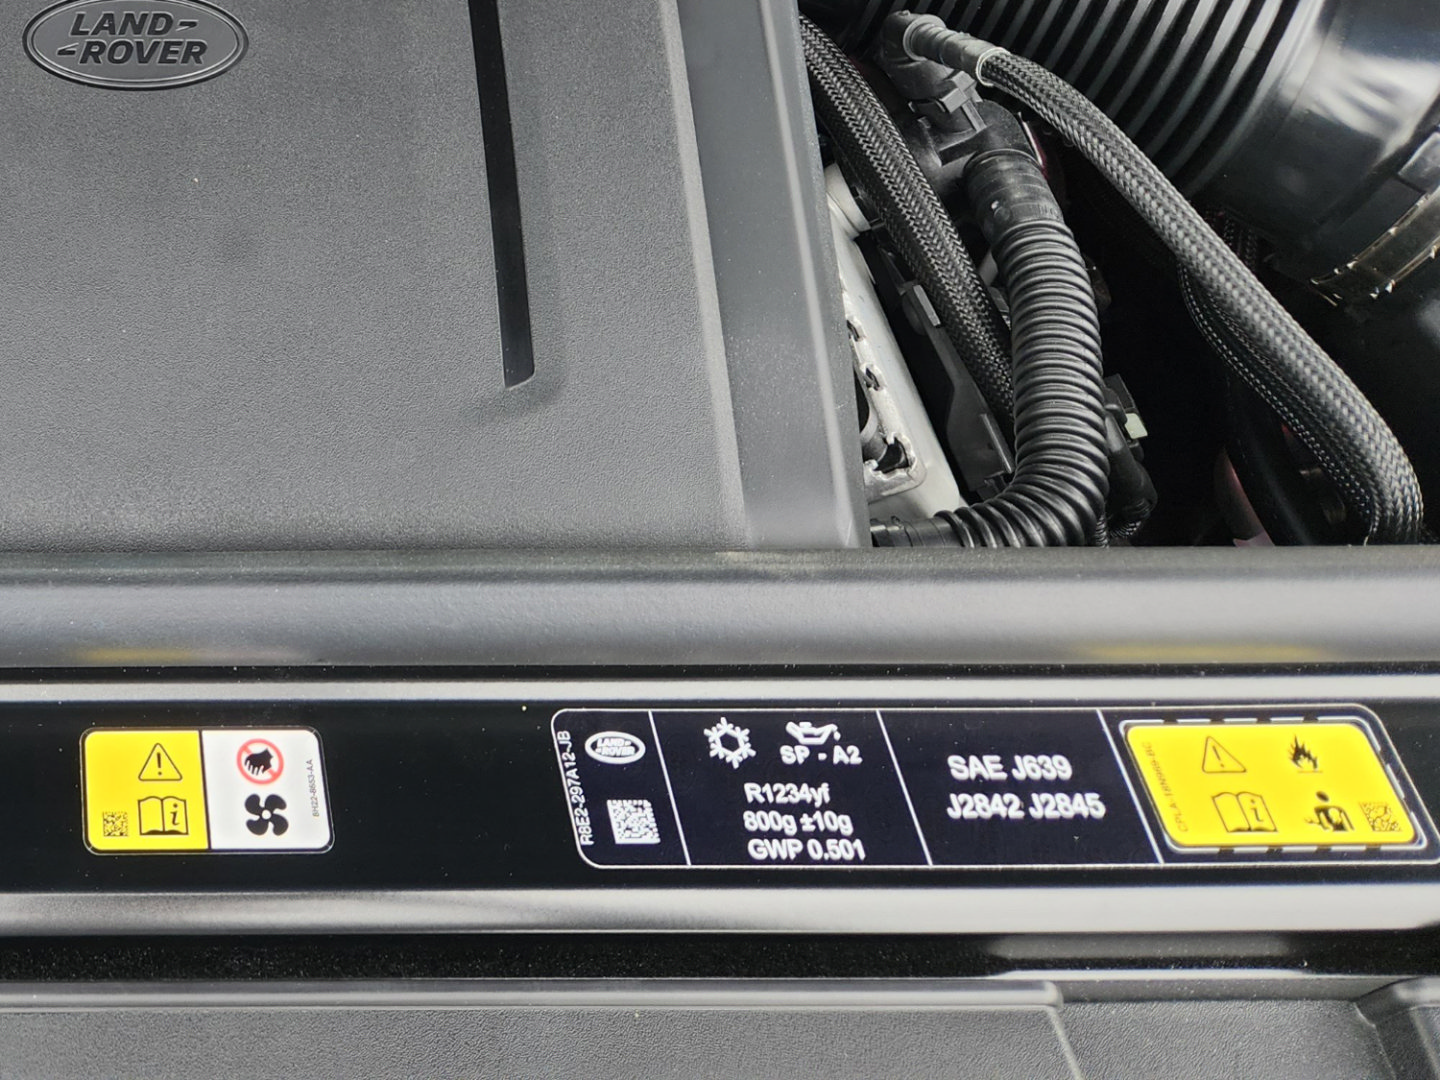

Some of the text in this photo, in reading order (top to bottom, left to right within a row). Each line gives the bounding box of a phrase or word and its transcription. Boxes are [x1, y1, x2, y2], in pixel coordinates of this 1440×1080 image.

[780, 746, 810, 764] SP
[833, 745, 862, 764] A2
[948, 755, 1072, 780] SAE J639
[744, 783, 830, 806] R1234yf
[947, 793, 1106, 818] J2842 J2845
[743, 811, 853, 836] 800g ±10g
[748, 839, 865, 860] GWP 0.501
